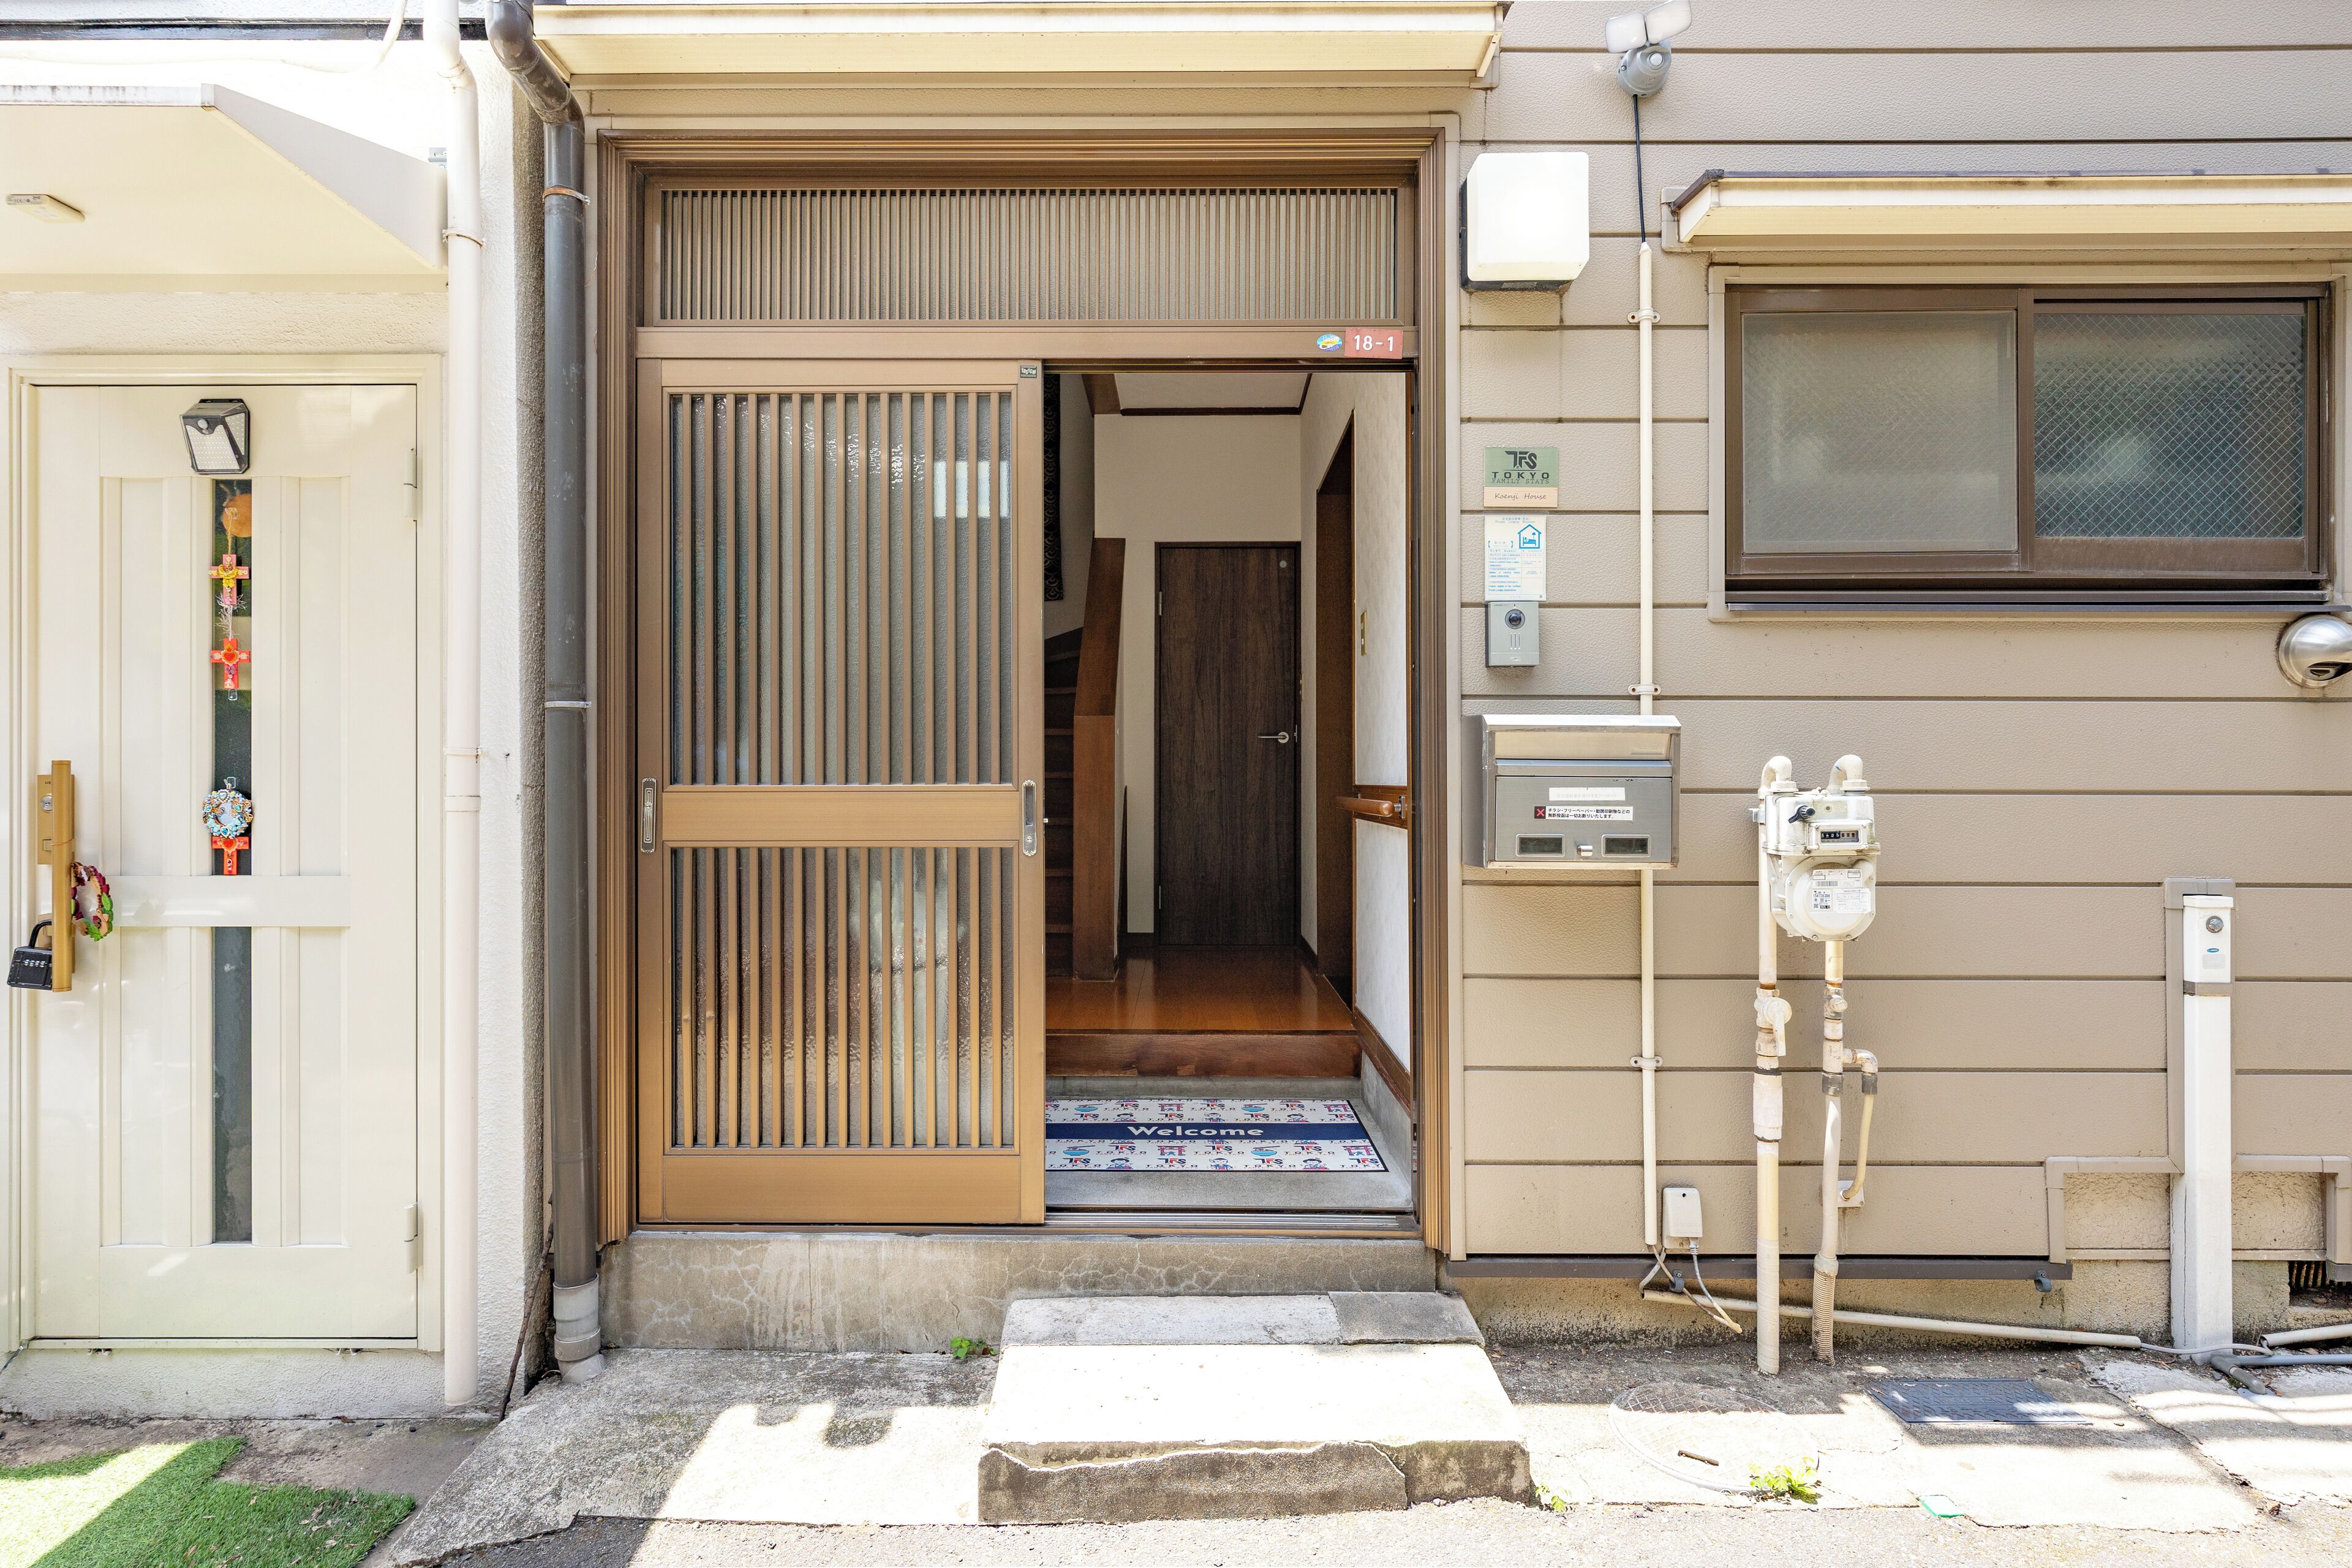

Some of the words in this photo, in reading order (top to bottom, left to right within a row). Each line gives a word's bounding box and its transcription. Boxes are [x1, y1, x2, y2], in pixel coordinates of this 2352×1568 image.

[1354, 334, 1393, 352] 18-1
[1504, 451, 1537, 470] TFS
[1127, 1126, 1264, 1136] Welcome
